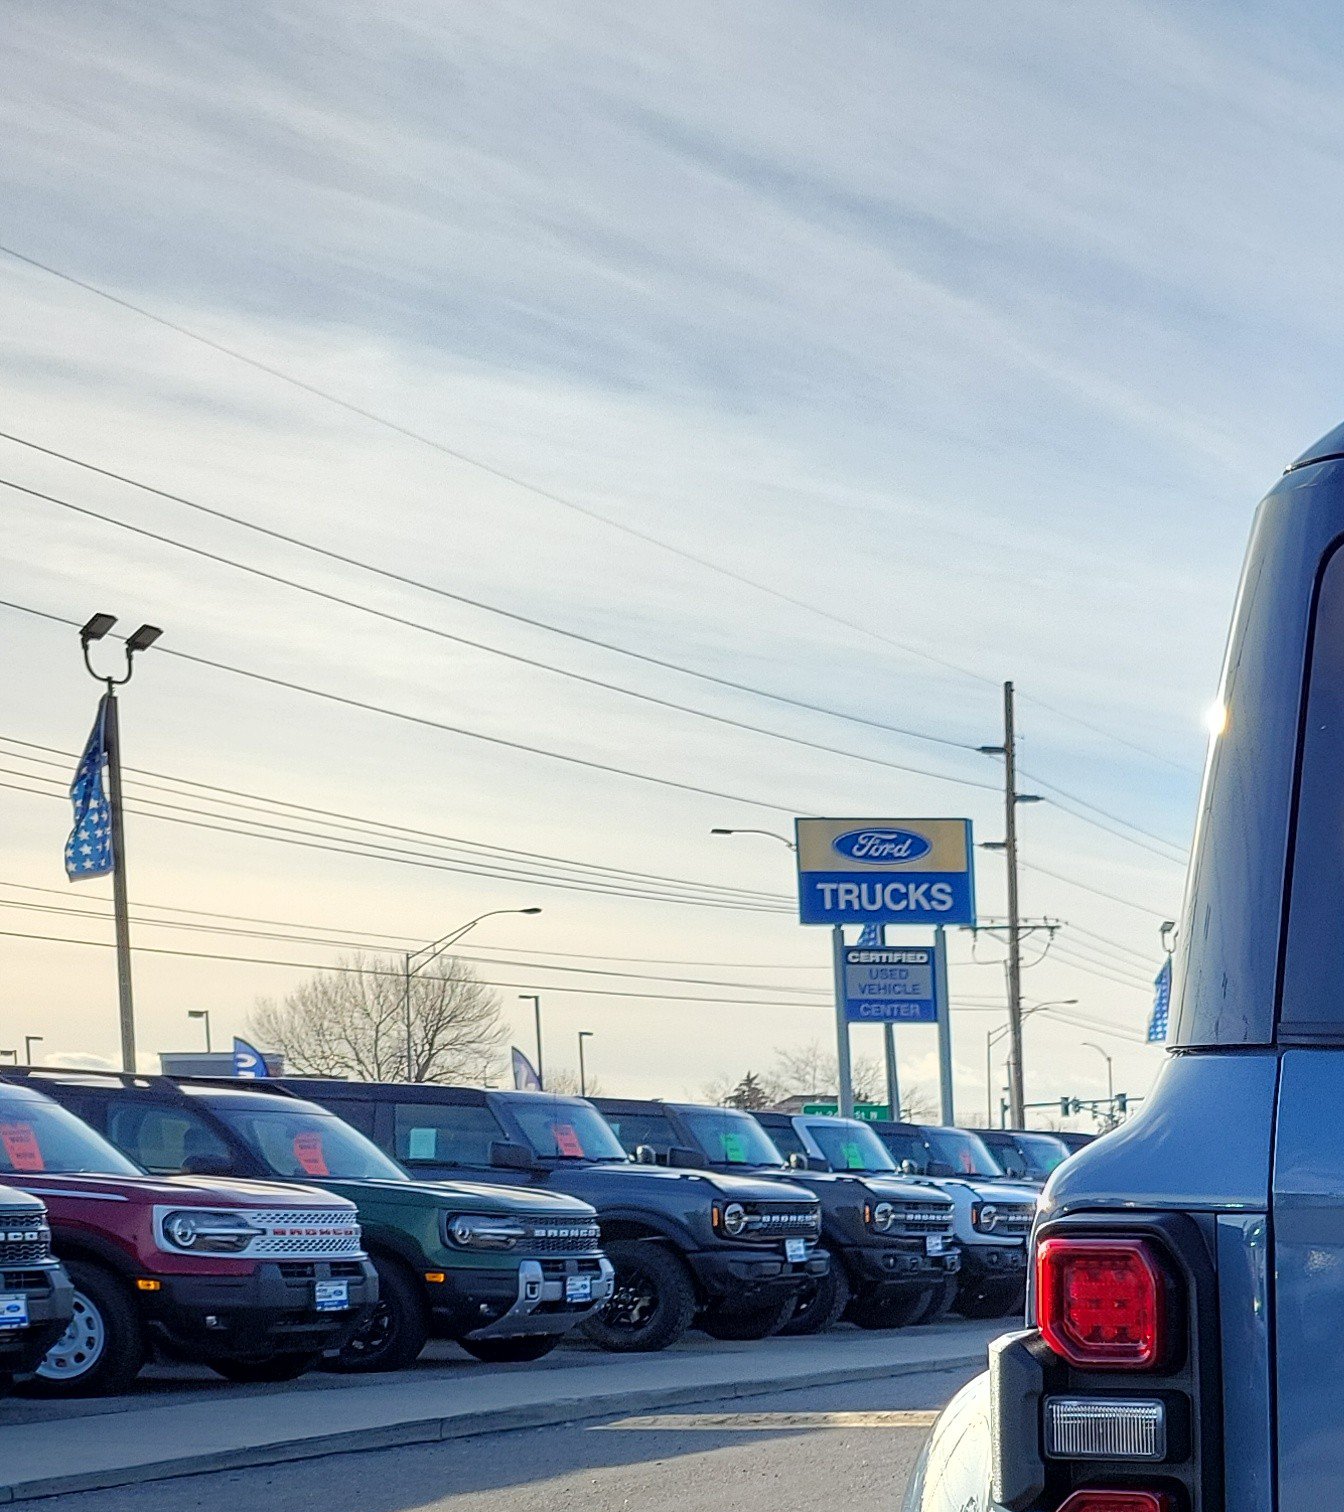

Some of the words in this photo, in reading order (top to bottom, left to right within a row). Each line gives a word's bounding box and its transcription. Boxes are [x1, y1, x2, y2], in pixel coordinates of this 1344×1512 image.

[852, 832, 911, 858] Ford
[816, 882, 953, 911] TRUCKS
[848, 950, 928, 964] CERTIFIED
[869, 968, 908, 980] USED
[859, 983, 921, 995] VEHICLE
[860, 1003, 920, 1016] CENTER
[533, 1229, 595, 1237] BRONCO
